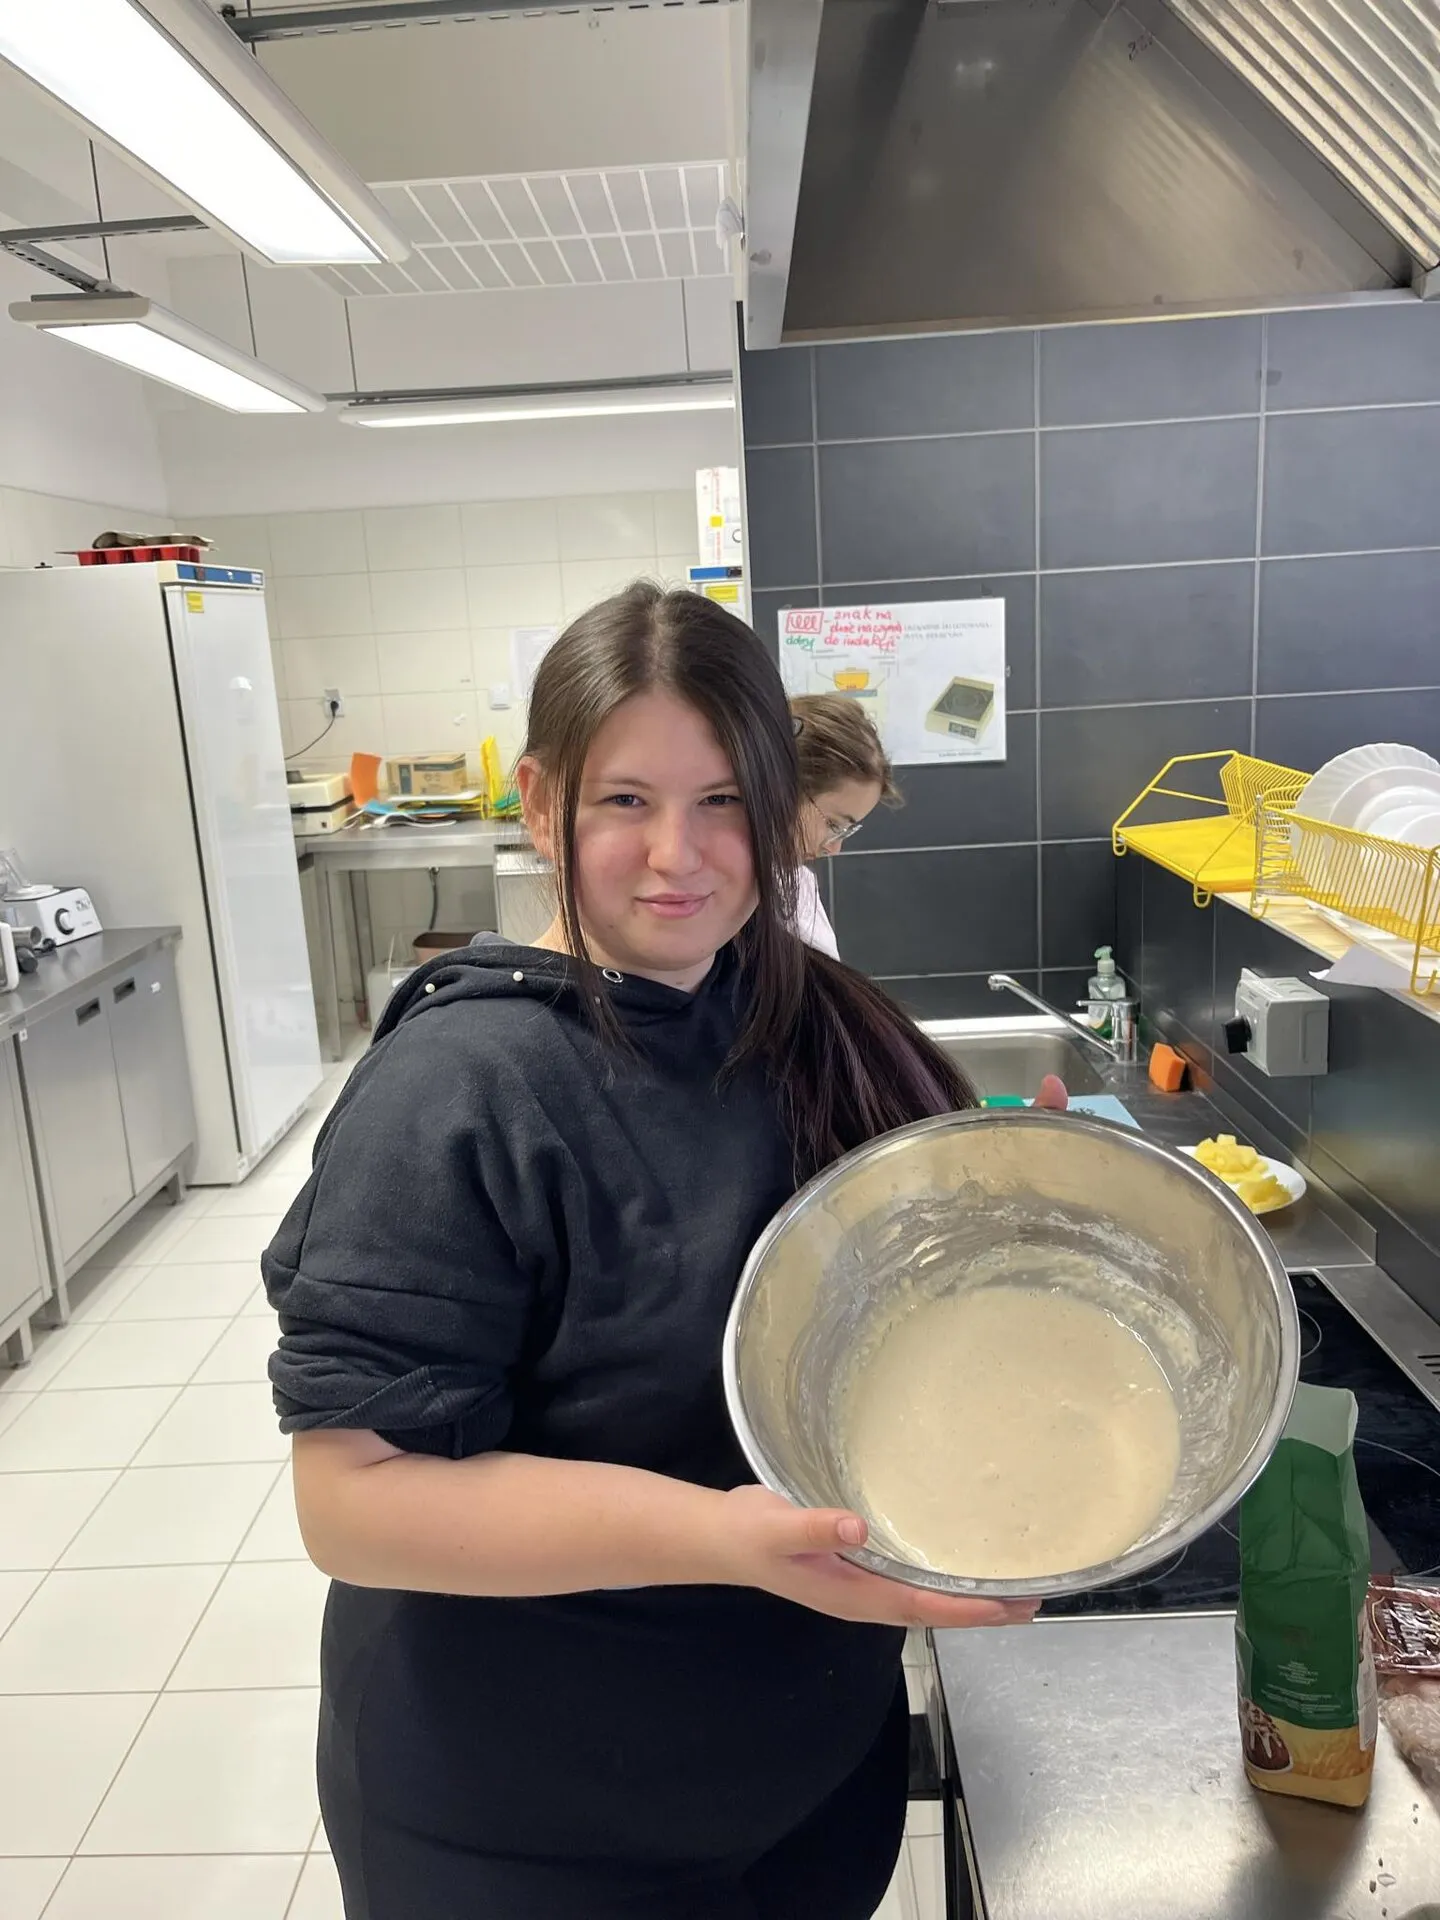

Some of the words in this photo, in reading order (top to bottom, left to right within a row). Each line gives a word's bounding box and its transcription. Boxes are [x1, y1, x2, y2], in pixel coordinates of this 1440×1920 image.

[834, 606, 871, 620] znak
[876, 610, 892, 620] na
[825, 634, 838, 645] do
